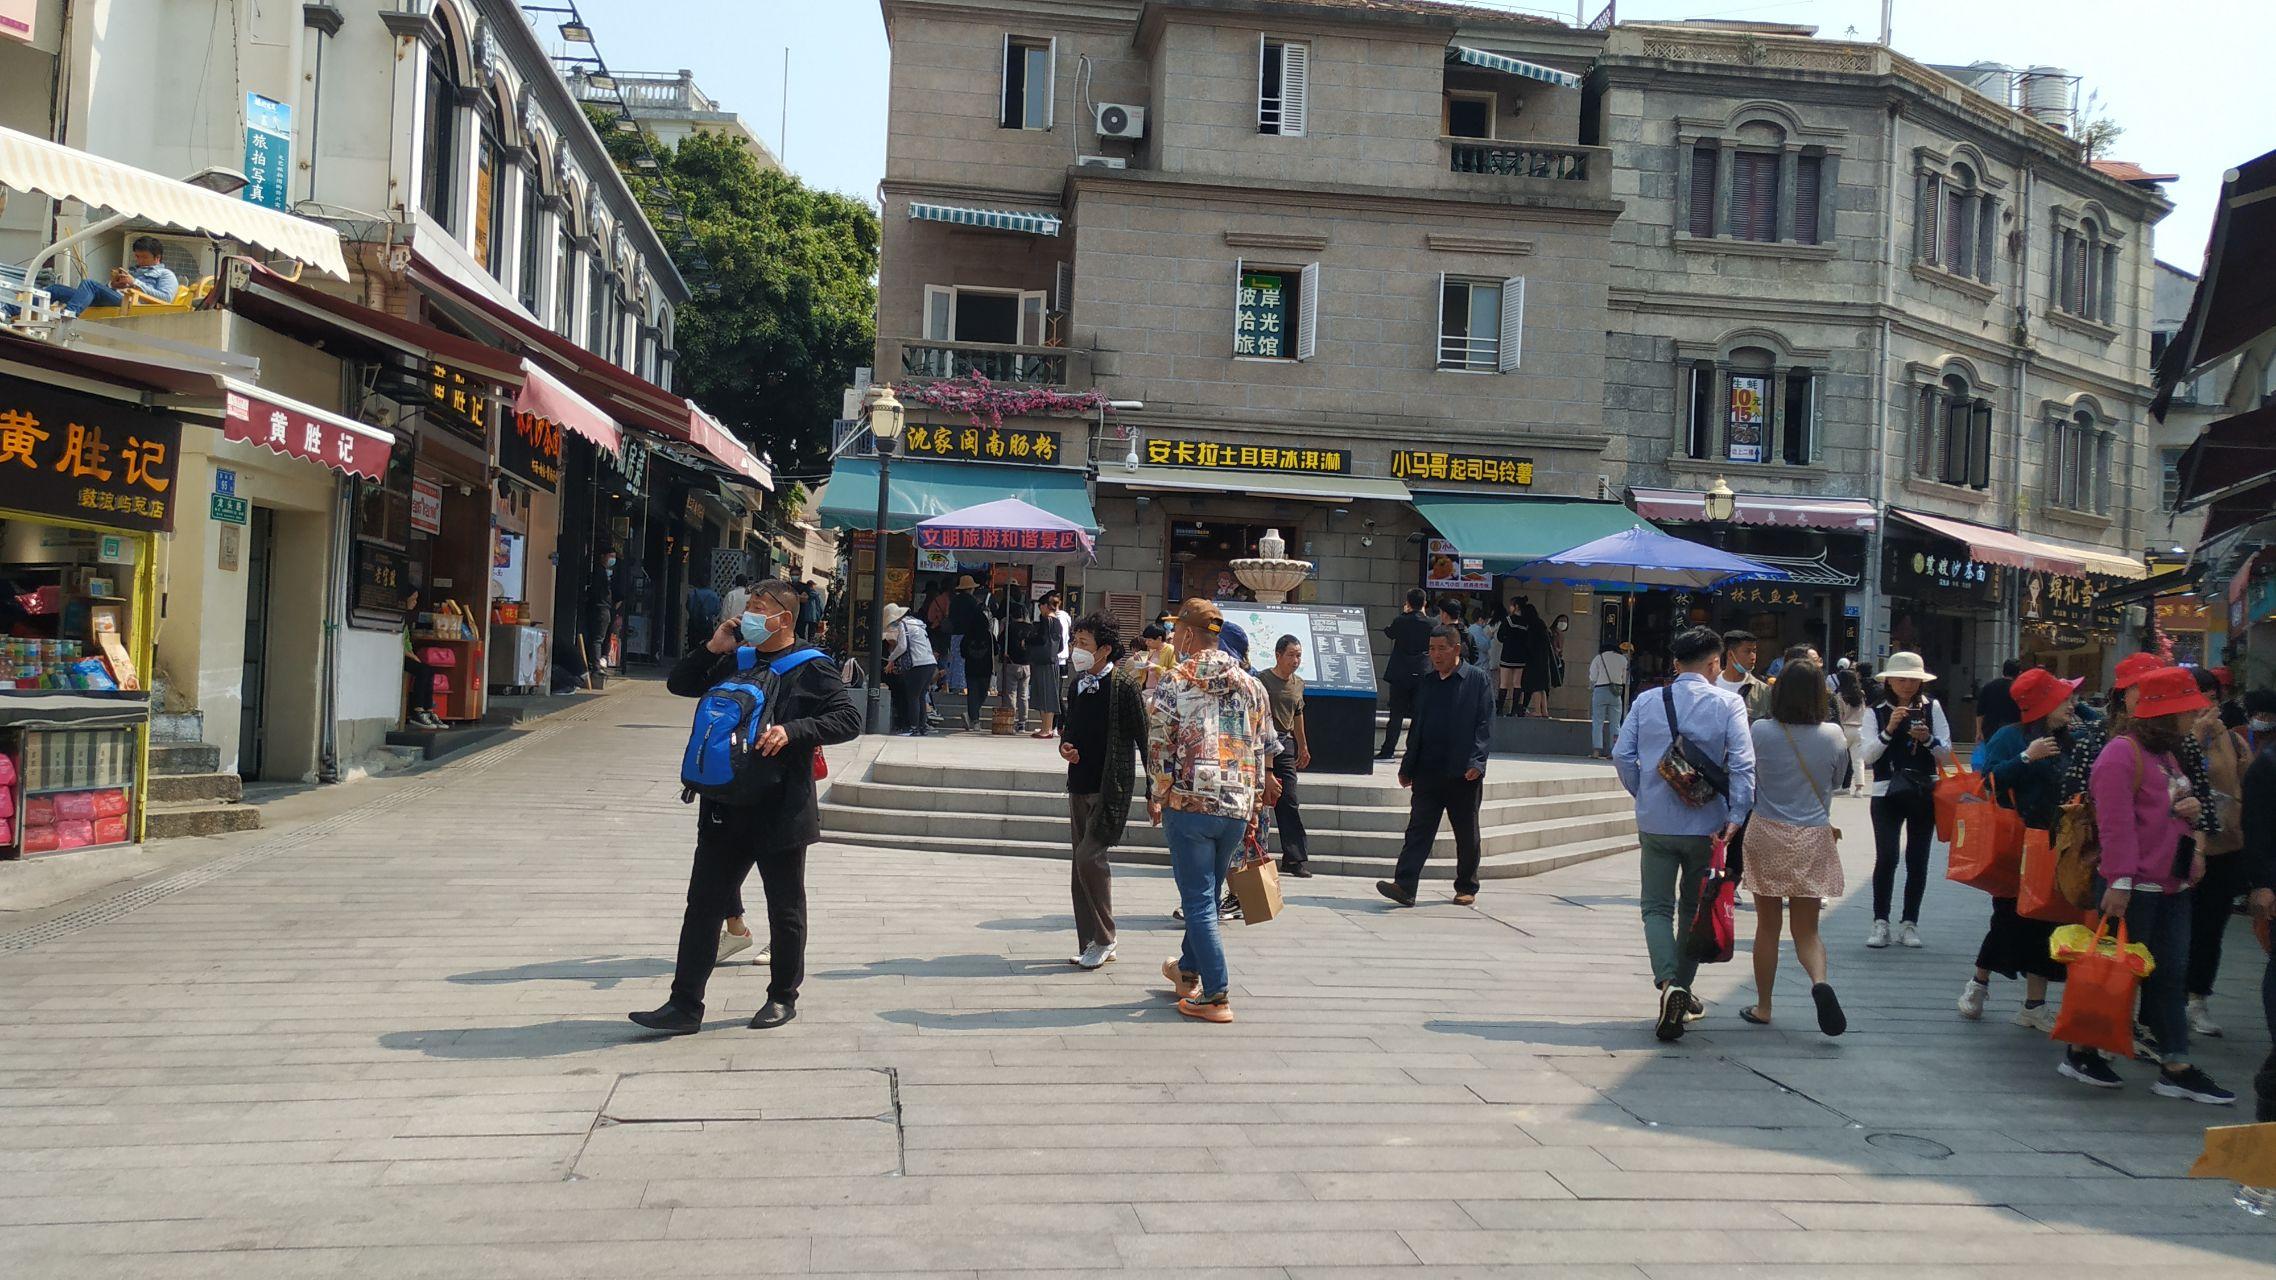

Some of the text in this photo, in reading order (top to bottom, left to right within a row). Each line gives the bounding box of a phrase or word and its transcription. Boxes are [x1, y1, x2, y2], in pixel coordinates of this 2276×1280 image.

[252, 134, 269, 202] 旅拍写真
[1238, 310, 1280, 332] 拾光
[1236, 334, 1279, 356] 旅馆
[0, 409, 170, 493] 黄胜记
[269, 411, 354, 464] 黄胜记
[907, 426, 1057, 460] 沈家闽南肠粉
[1148, 440, 1341, 471] 安卡拉土耳其冰淇淋
[923, 528, 1076, 549] 文明旅游和谐景区
[1730, 588, 1803, 605] 林氏鱼丸
